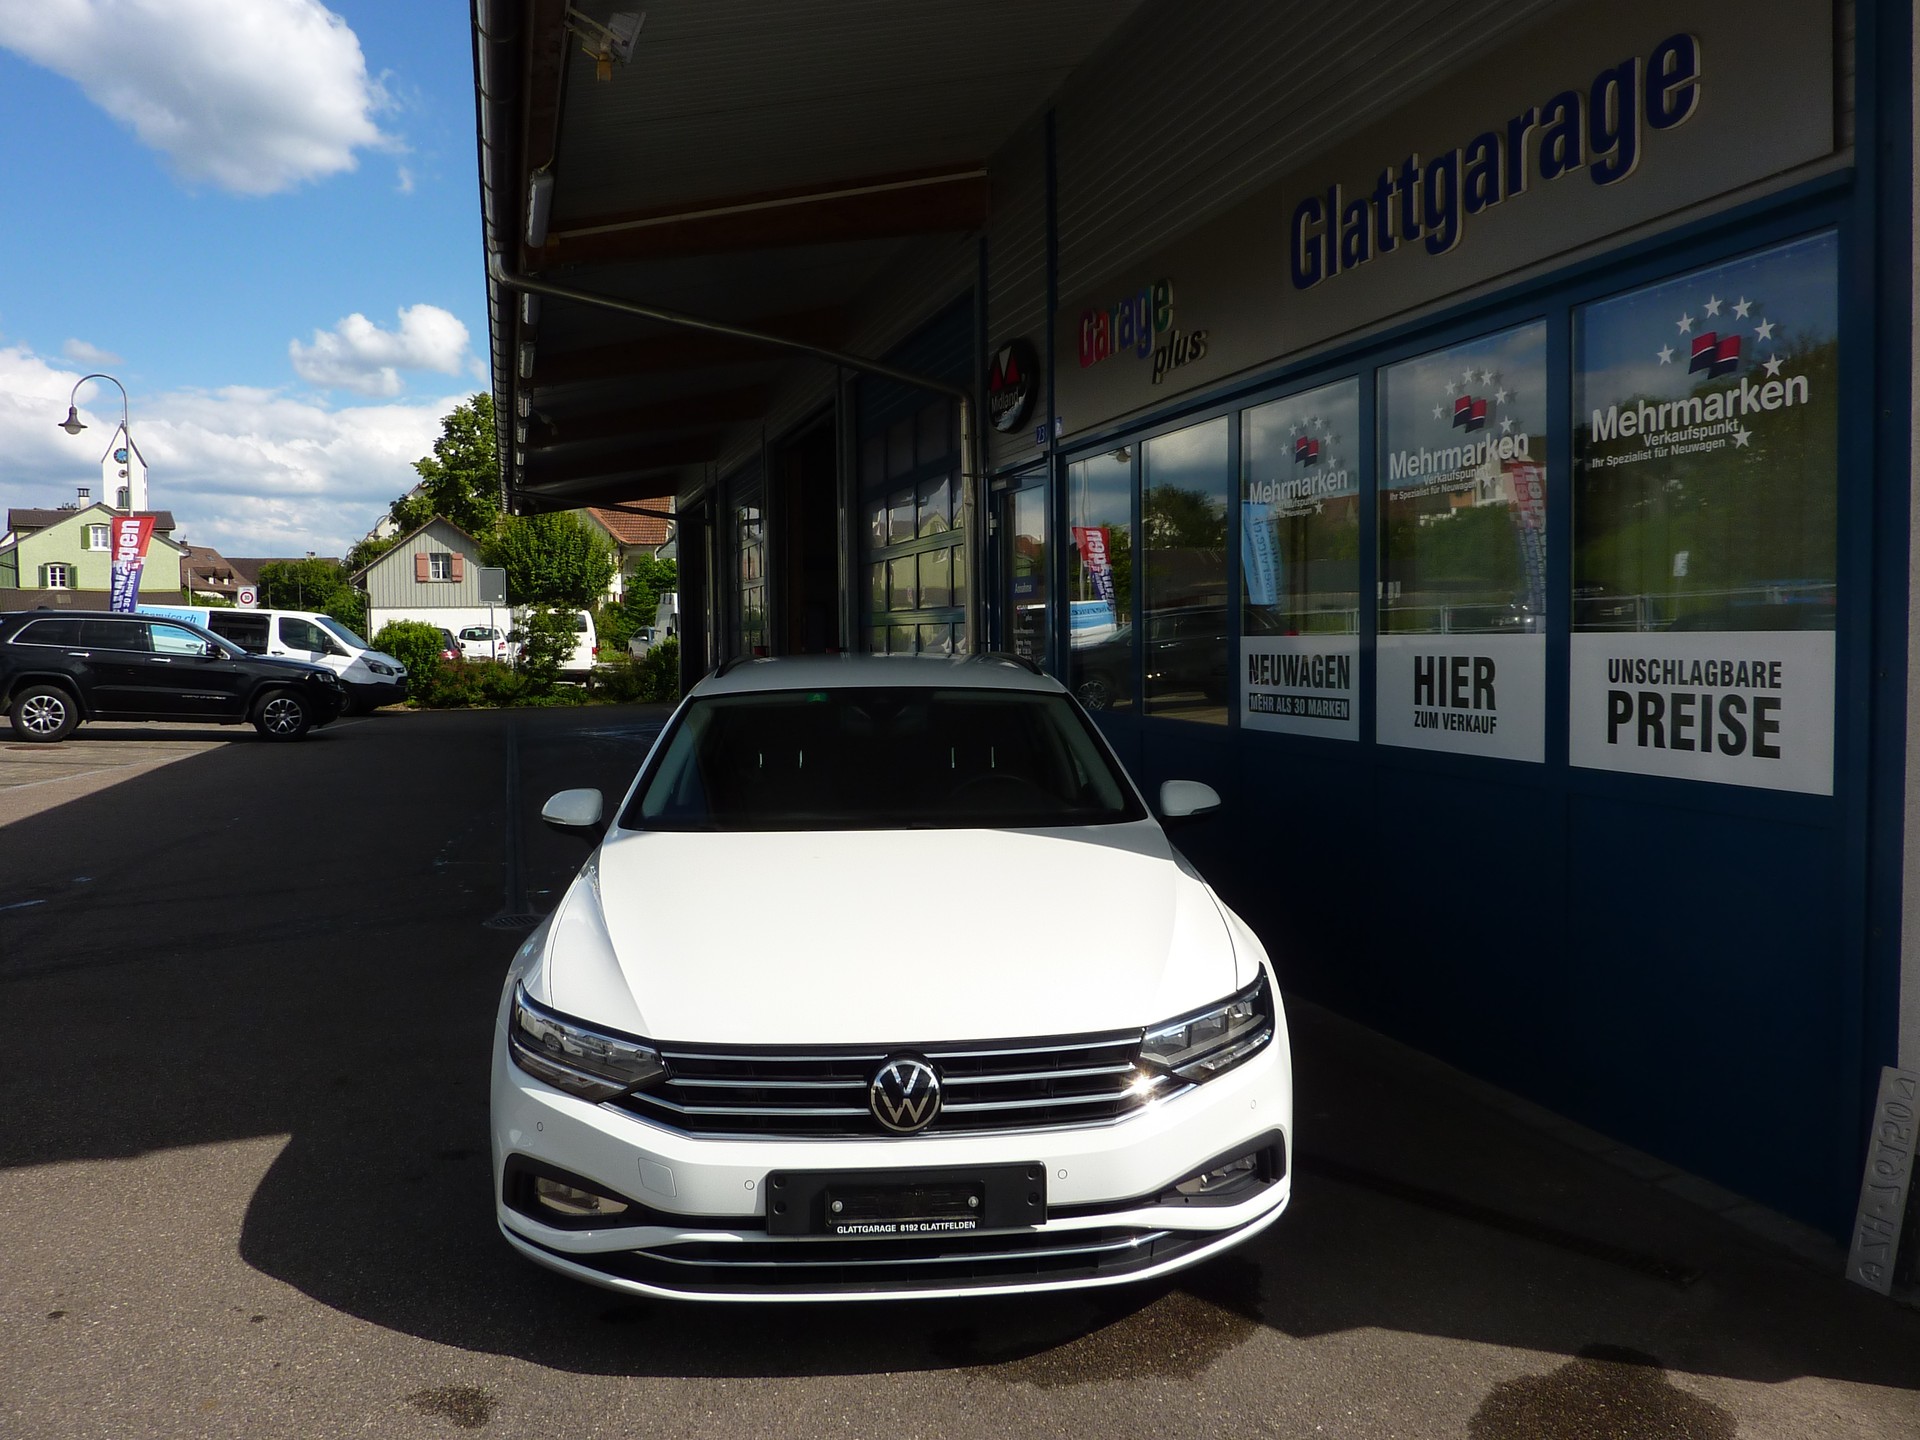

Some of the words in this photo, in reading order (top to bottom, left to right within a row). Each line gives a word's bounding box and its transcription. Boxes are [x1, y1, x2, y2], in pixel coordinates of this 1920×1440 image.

[1291, 33, 1700, 290] Glattgarage
[1079, 279, 1174, 369] Garage
[1152, 330, 1207, 384] plus
[991, 386, 1019, 414] Midland
[1592, 375, 1809, 443] Mehrmarken
[1037, 426, 1045, 443] 23
[1643, 419, 1740, 448] Verkaufspunkt
[1389, 433, 1530, 480] Mehrmarken
[1592, 457, 1605, 469] Ihr
[1606, 449, 1653, 468] Spezialist
[1654, 446, 1668, 459] für
[1671, 438, 1727, 456] Neuwagen
[1249, 469, 1348, 505] Mehrmarken
[1399, 485, 1430, 501] Spezialist
[1441, 480, 1478, 493] Neuwagen
[1249, 654, 1350, 690] NEUWAGEN
[1413, 655, 1497, 711] HIER
[1608, 658, 1783, 689] UNSCHLAGBARE
[1250, 694, 1275, 712] MEHR
[1276, 696, 1292, 713] ALS
[1294, 698, 1306, 715] 30
[1308, 699, 1348, 718] MARKEN
[1413, 710, 1440, 732] ZUM
[1442, 712, 1498, 735] VERKAUF
[1607, 690, 1782, 760] PREISE
[836, 1224, 897, 1234] GLATTGARAGE
[899, 1223, 919, 1232] 8192
[920, 1221, 976, 1231] GLATTFELDEN
